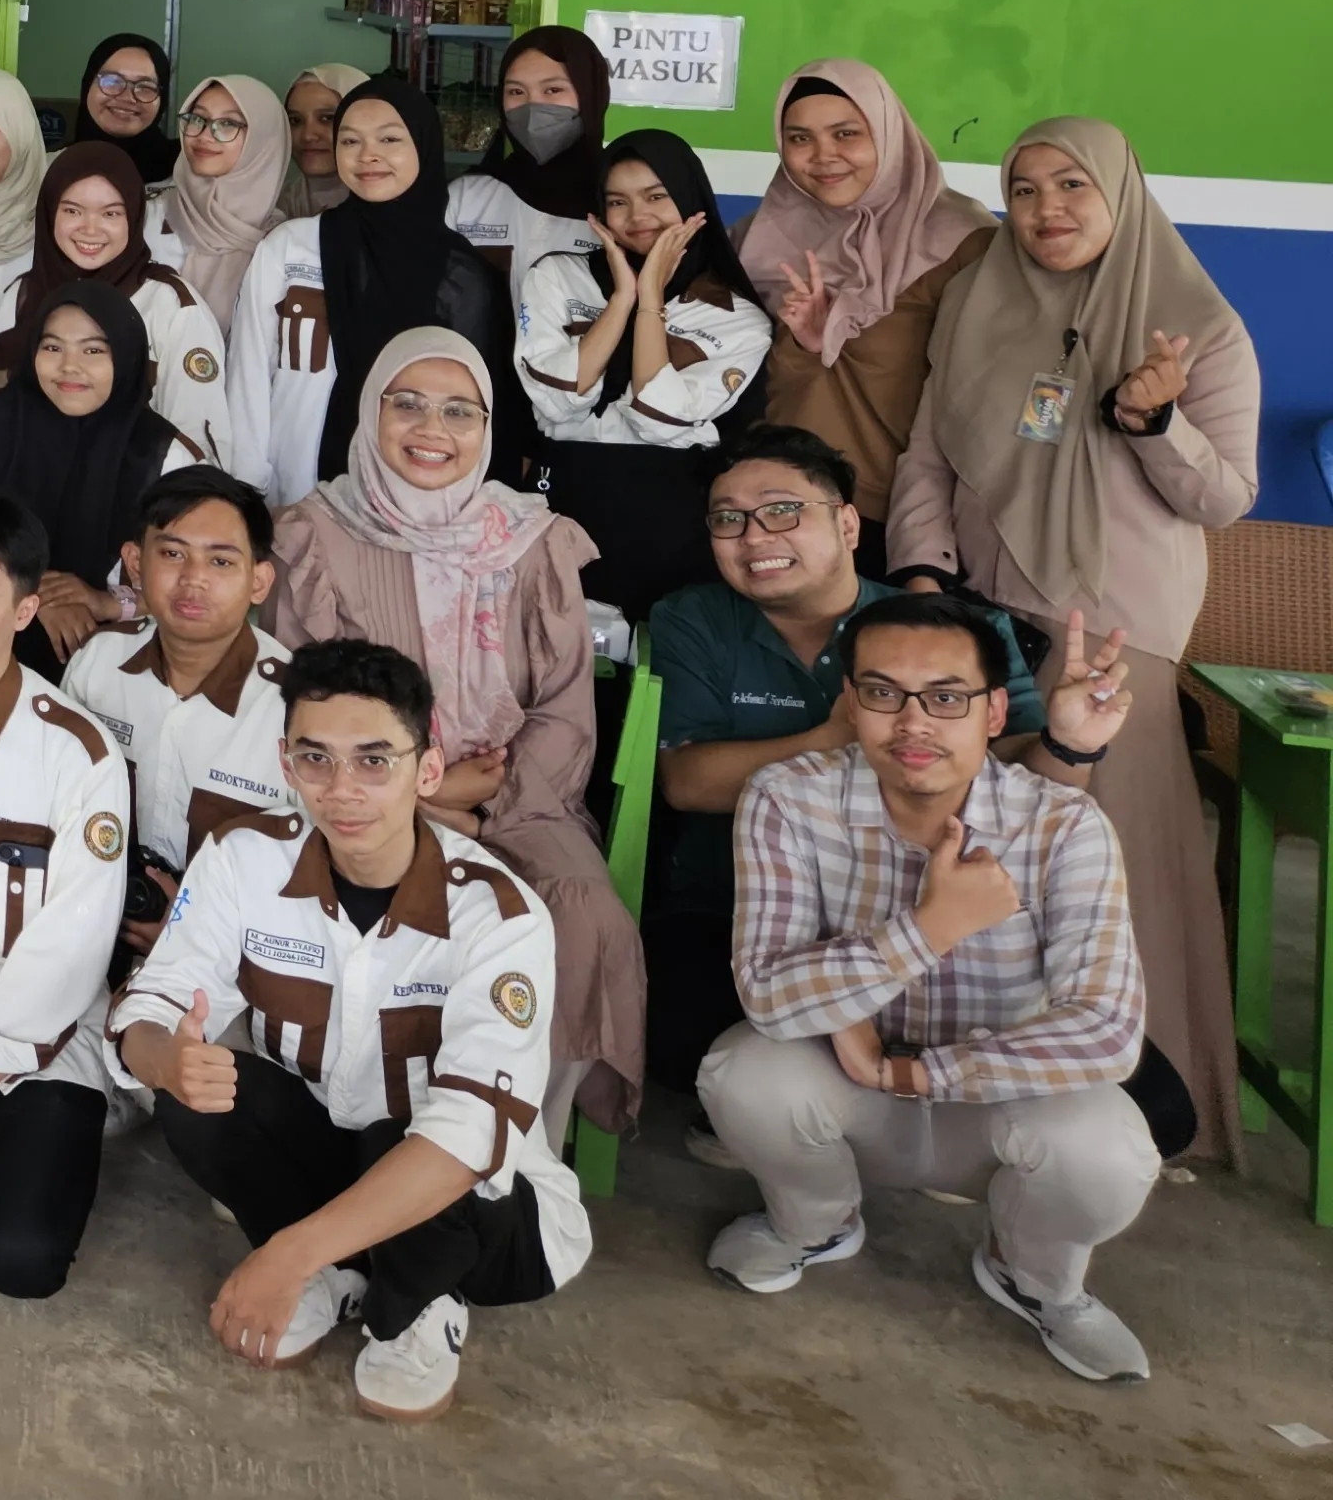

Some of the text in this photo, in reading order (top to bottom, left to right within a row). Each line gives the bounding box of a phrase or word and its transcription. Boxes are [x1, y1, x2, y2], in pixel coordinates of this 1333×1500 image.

[612, 27, 710, 52] PINTU
[605, 57, 718, 84] MASUK
[209, 768, 279, 798] KEDOKTERAN 24
[250, 932, 260, 941] M.
[263, 937, 290, 948] AUNUR
